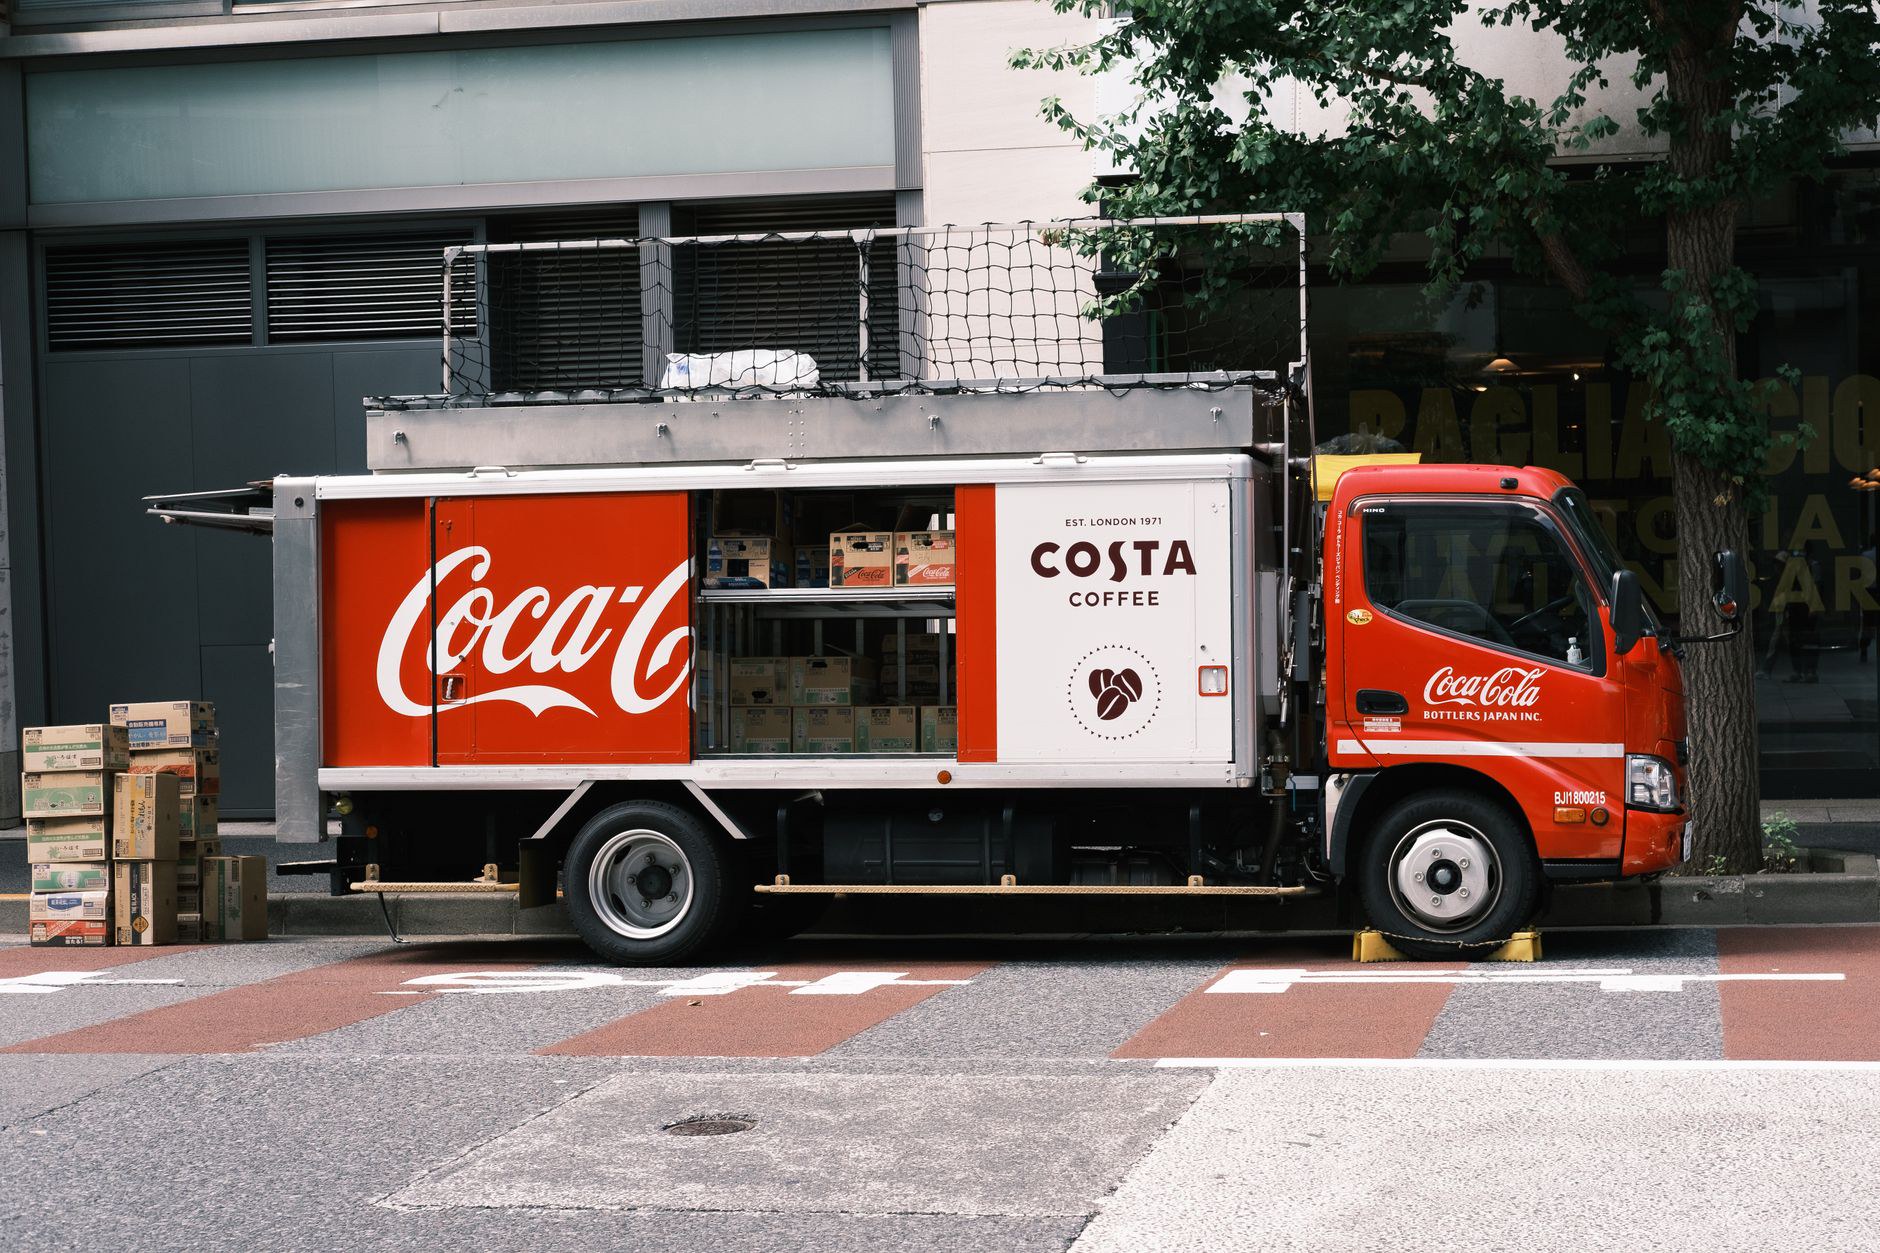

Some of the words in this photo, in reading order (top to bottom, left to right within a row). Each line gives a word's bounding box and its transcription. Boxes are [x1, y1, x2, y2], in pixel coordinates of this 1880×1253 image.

[1349, 374, 1880, 480] PAGLIACIO
[1065, 518, 1087, 527] EST.
[1090, 517, 1137, 526] LONDON
[1139, 517, 1163, 526] 1971
[922, 567, 950, 577] Coca-Cola
[1030, 539, 1197, 583] COSTA
[1068, 590, 1160, 607] COFFEE
[1749, 555, 1880, 613] AR
[376, 545, 696, 718] Coca-C
[1423, 666, 1549, 707] Coca-Cola
[1423, 711, 1481, 721] BOTTLERS
[1483, 711, 1518, 722] JAPAN
[1520, 711, 1543, 721] INC.
[1554, 791, 1606, 805] BJI1800215
